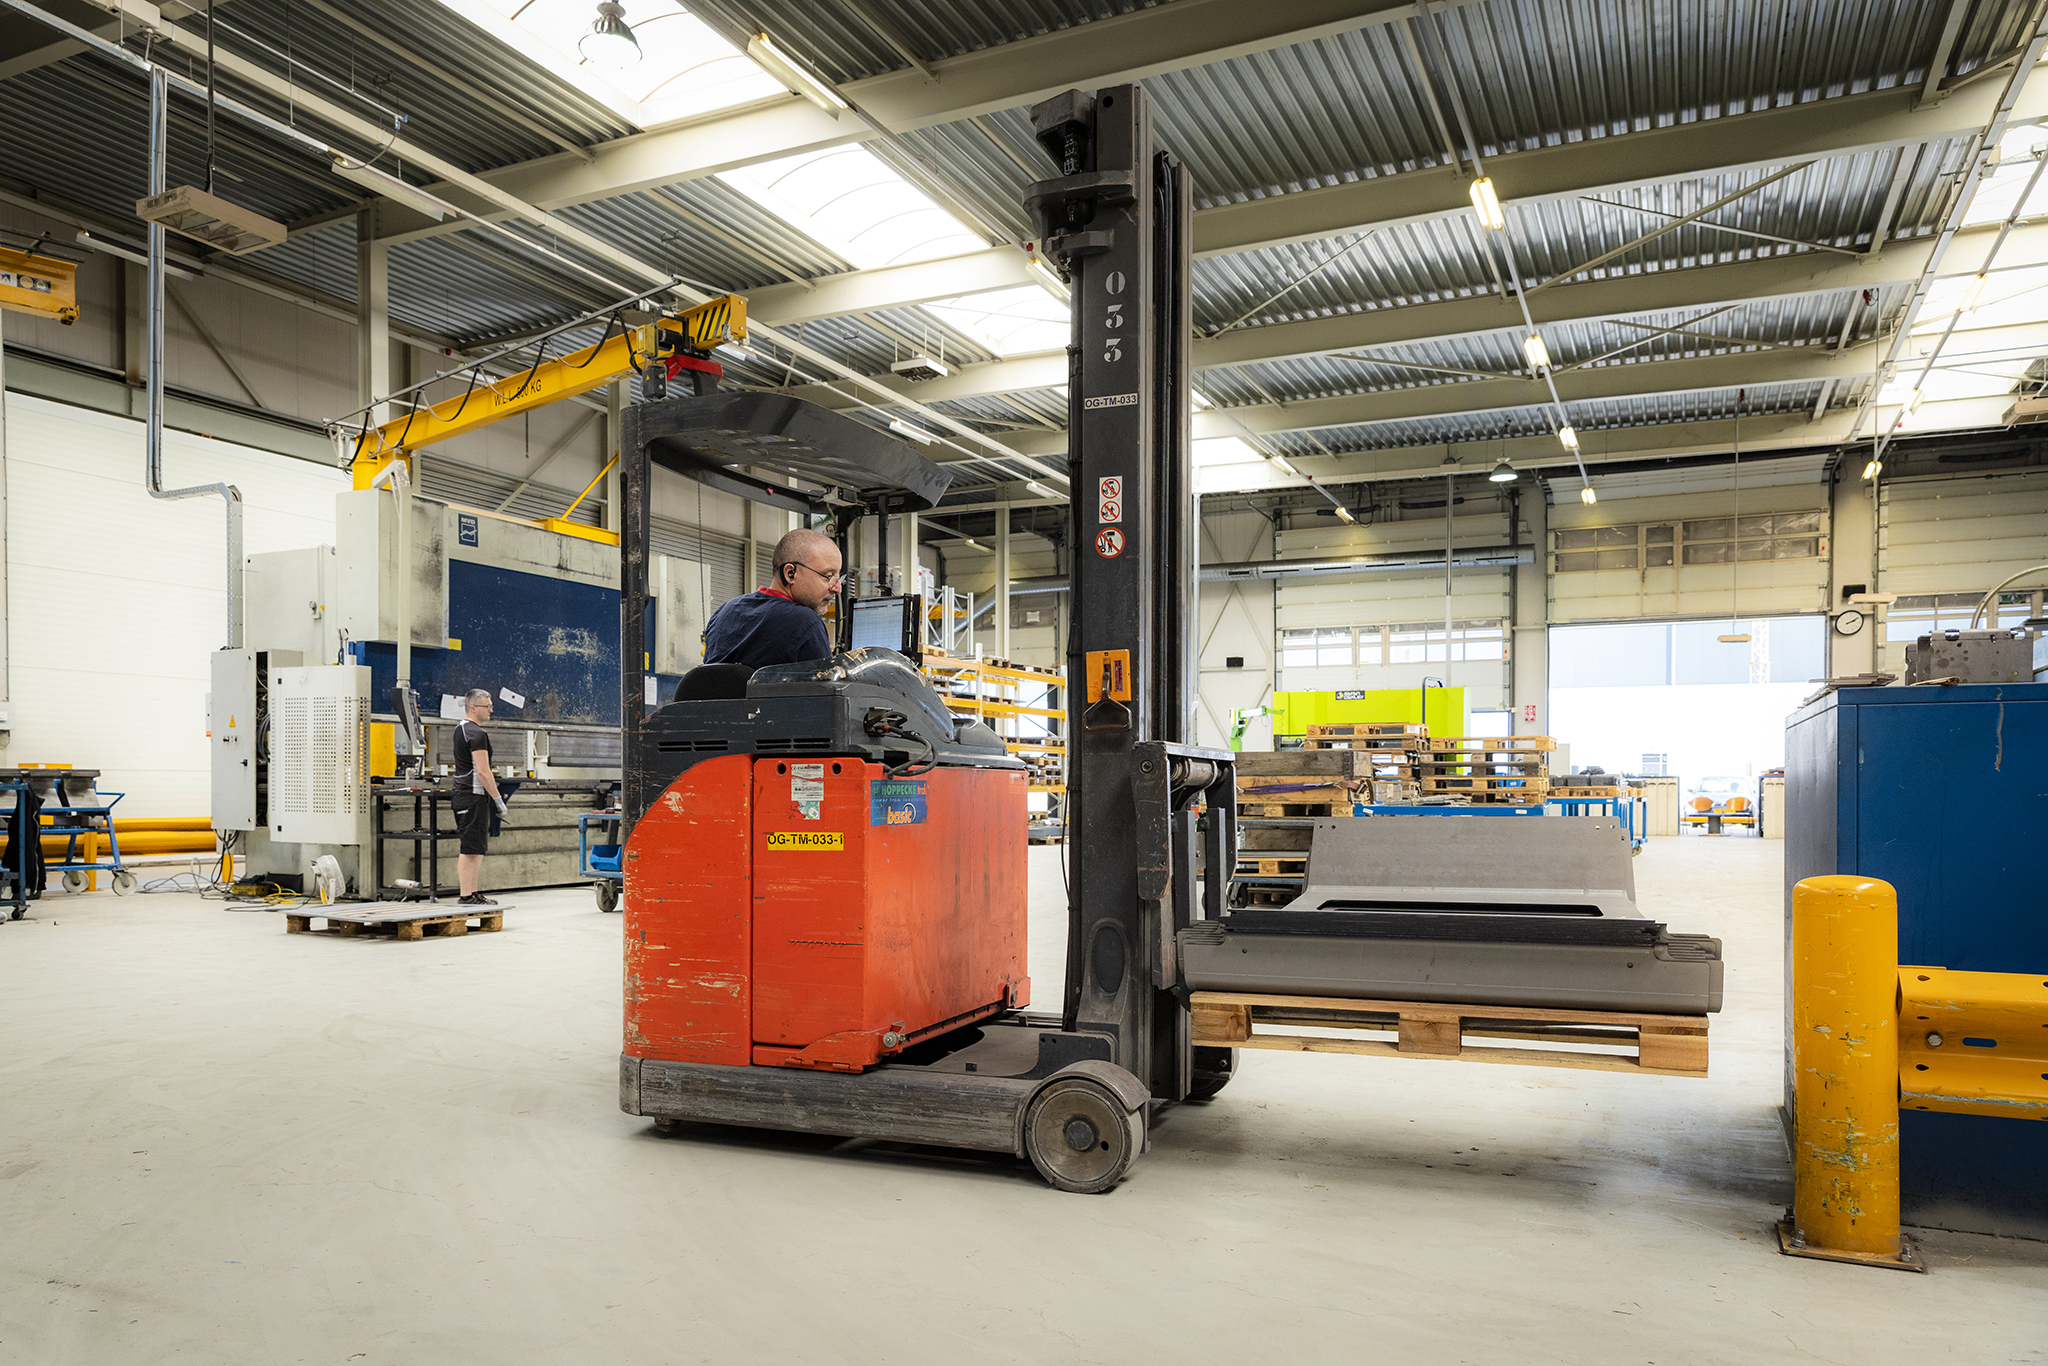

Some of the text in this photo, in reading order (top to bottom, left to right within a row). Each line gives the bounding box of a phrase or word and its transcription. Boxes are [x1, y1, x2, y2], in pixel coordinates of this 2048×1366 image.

[530, 379, 541, 394] KG
[1085, 394, 1137, 408] OG-TM-033
[881, 785, 916, 795] HOPPECKE
[887, 806, 912, 825] basic
[767, 833, 843, 845] OG-TM-033-1
